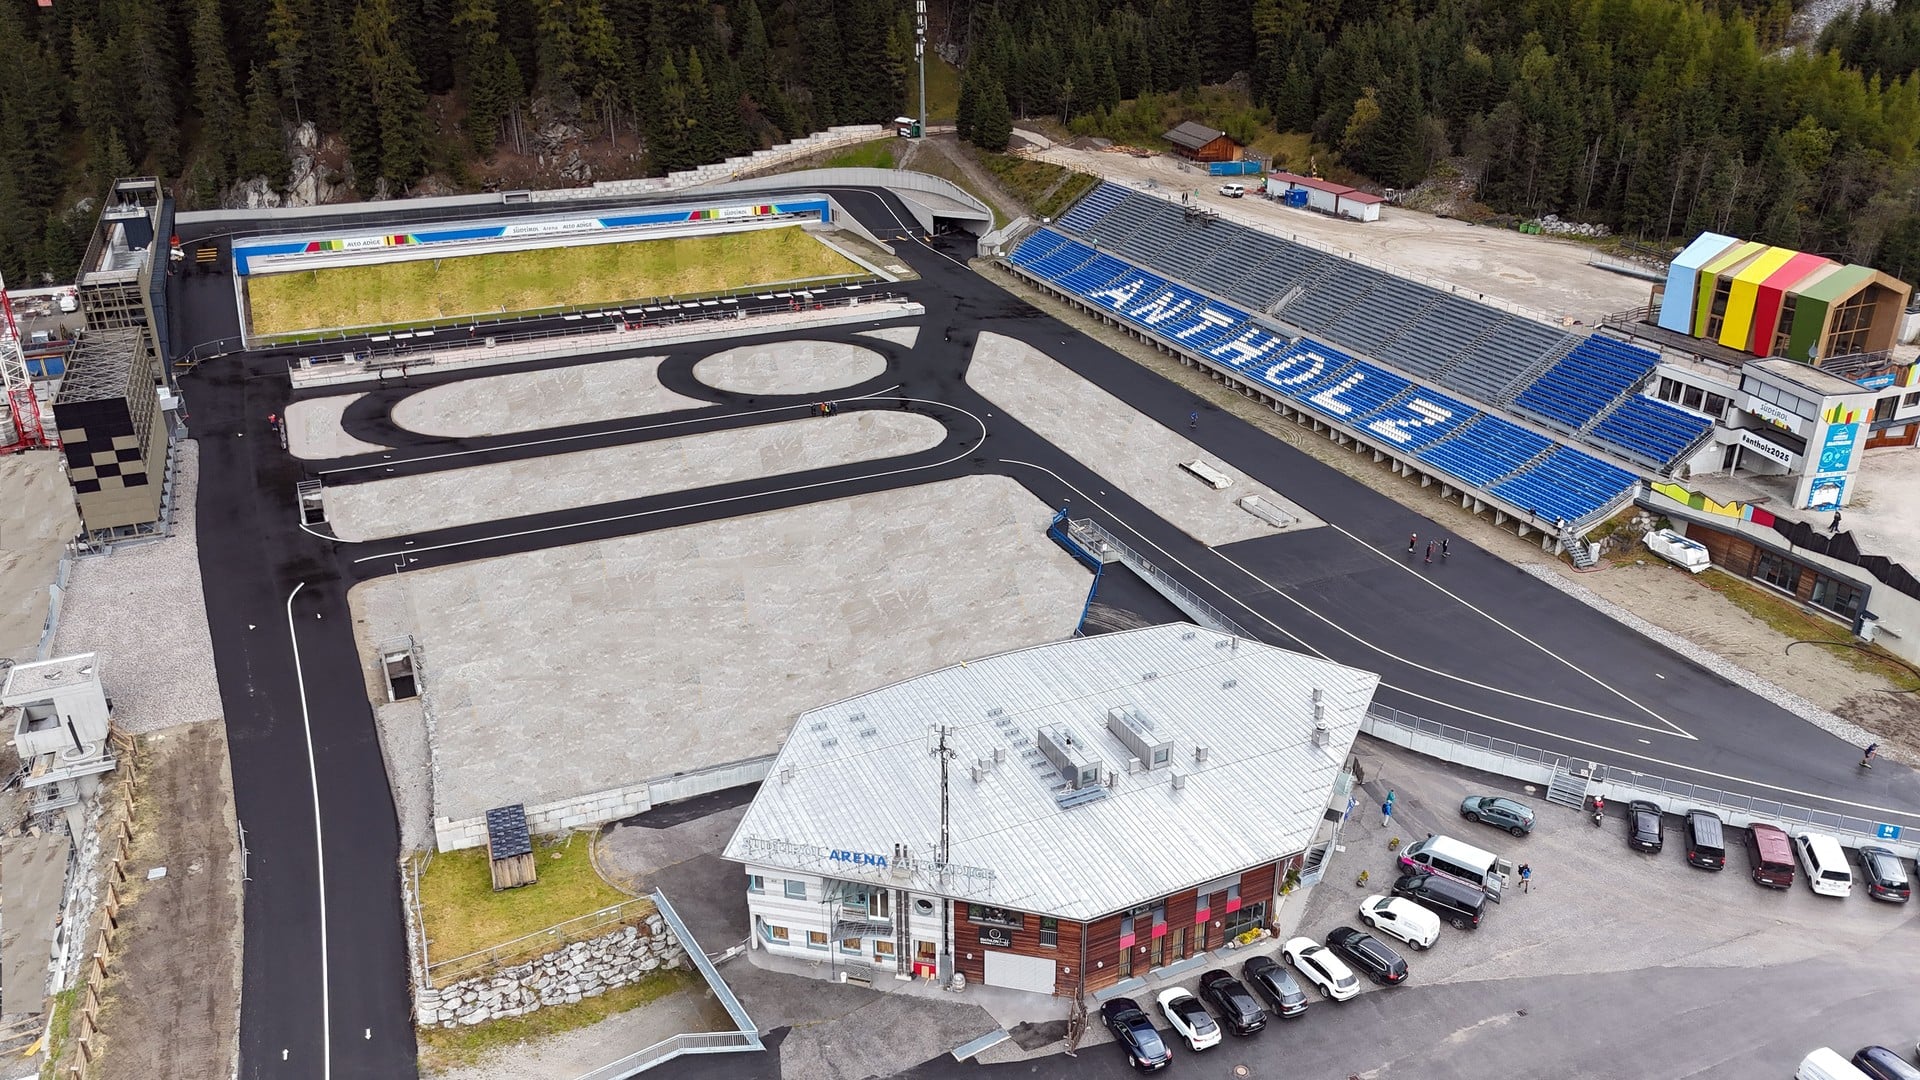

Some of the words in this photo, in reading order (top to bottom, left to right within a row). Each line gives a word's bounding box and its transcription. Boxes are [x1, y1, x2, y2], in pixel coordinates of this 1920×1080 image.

[1089, 279, 1452, 443] ANTHOLZ
[1742, 434, 1790, 462] #antholz2025
[829, 849, 888, 868] ARENA
